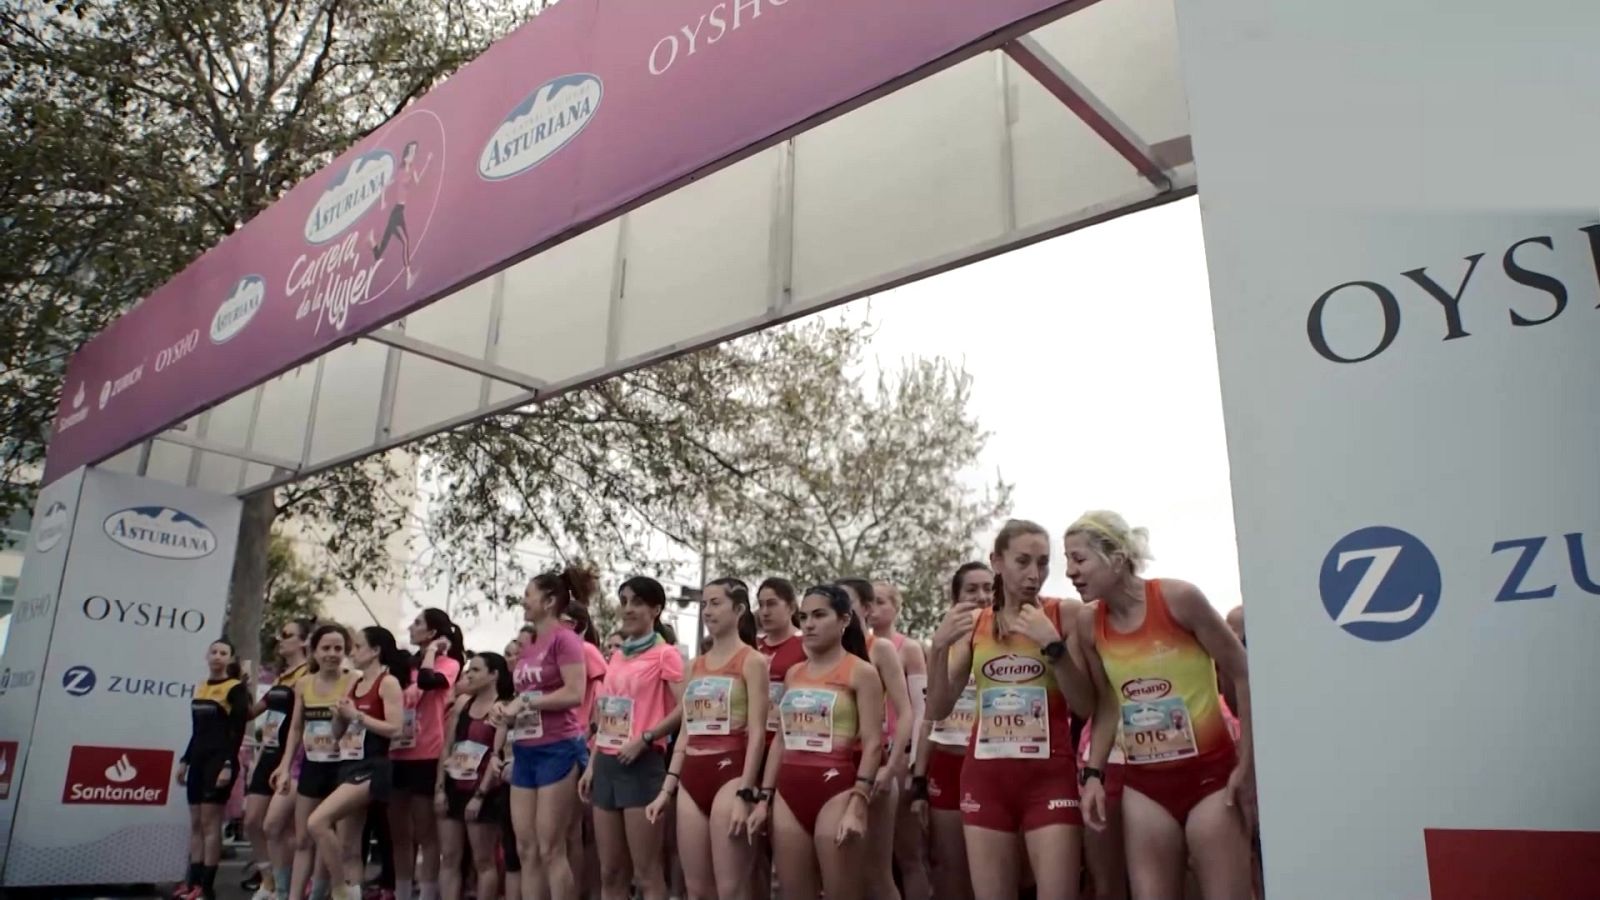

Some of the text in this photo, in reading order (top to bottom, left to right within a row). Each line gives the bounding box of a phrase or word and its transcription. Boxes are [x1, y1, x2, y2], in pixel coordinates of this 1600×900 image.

[648, 0, 788, 76] OYSH
[484, 96, 591, 172] ASTURIANA
[310, 171, 386, 236] ASTURIANA
[111, 517, 209, 552] ASTURIANA
[82, 595, 206, 633] OYSHO
[989, 662, 1042, 677] Serrano
[107, 675, 196, 700] ZURICH
[1126, 683, 1168, 697] Serrano
[993, 714, 1025, 727] 016
[1135, 730, 1167, 745] 016
[70, 783, 163, 802] Santander
